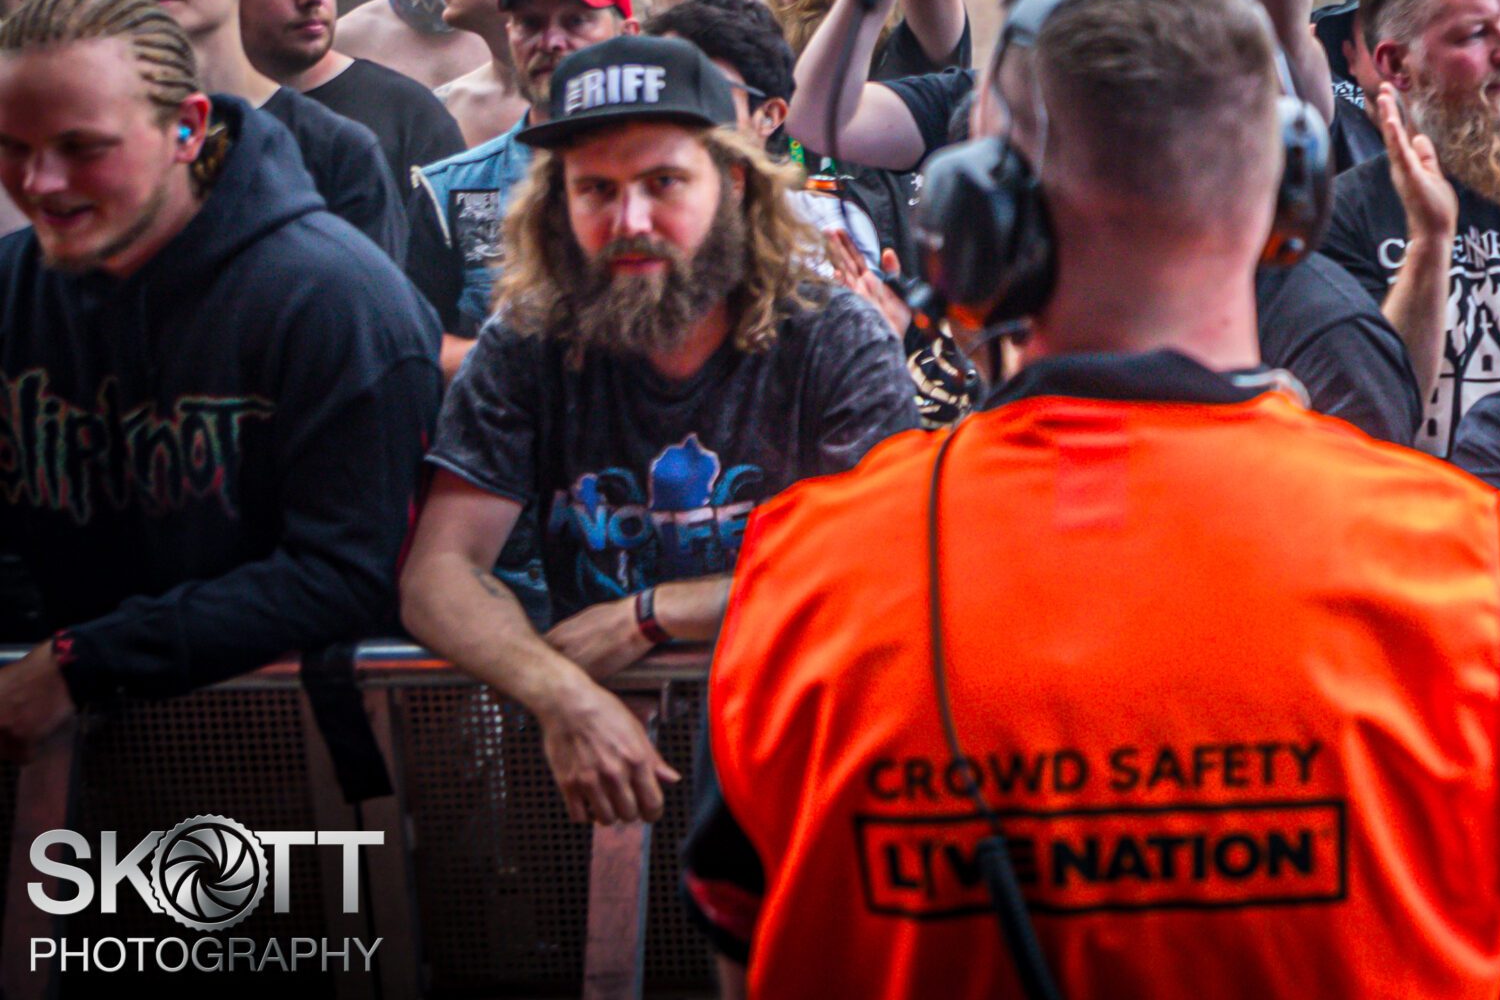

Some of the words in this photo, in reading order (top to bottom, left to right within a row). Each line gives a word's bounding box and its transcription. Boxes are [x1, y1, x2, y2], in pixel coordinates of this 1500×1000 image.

[582, 63, 667, 111] RIFF
[866, 750, 1089, 800] CROWD
[1109, 740, 1323, 792] SAFETY
[884, 834, 1038, 895] LIVE
[1050, 829, 1313, 887] NATION
